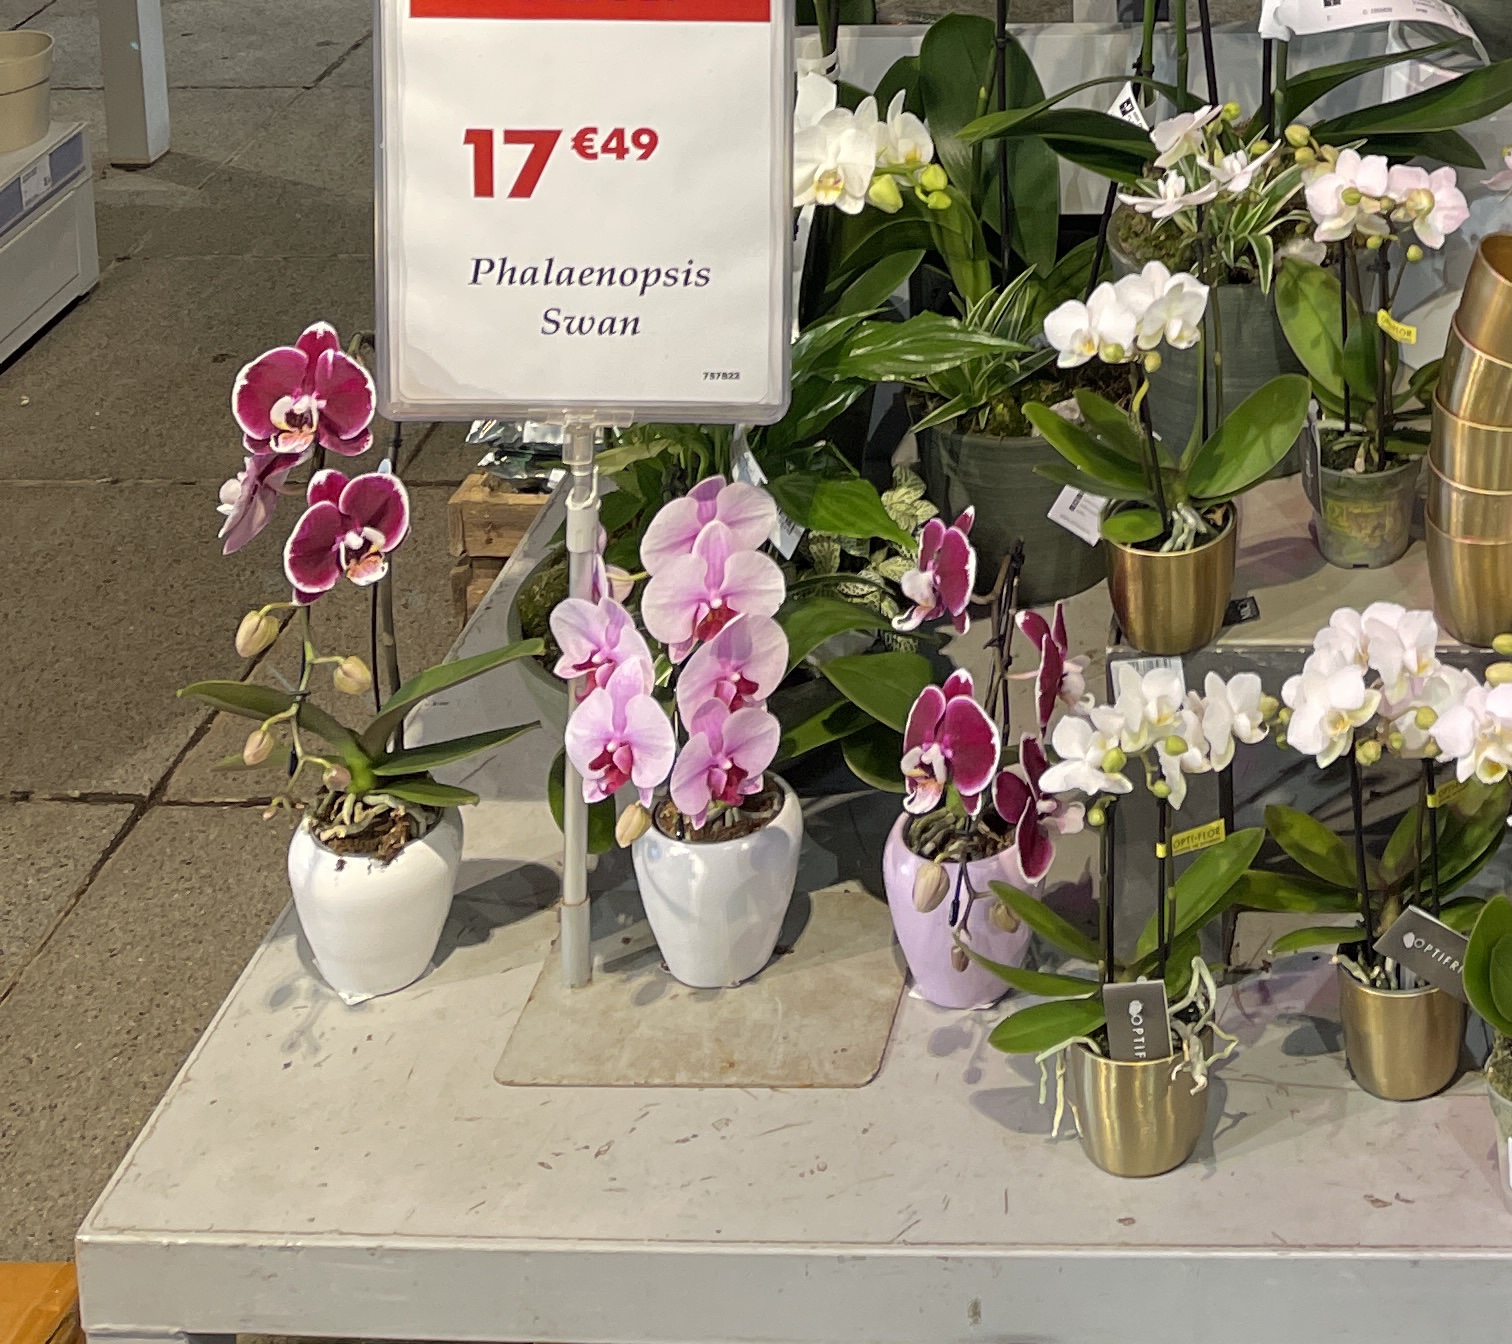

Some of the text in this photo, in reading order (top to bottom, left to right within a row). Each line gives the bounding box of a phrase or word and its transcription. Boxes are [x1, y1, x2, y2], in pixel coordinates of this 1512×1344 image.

[469, 256, 712, 296] Phalaenopsis
[540, 307, 642, 337] Swan
[1414, 938, 1464, 974] OPTIFRI
[1131, 1014, 1147, 1058] OPTIF
